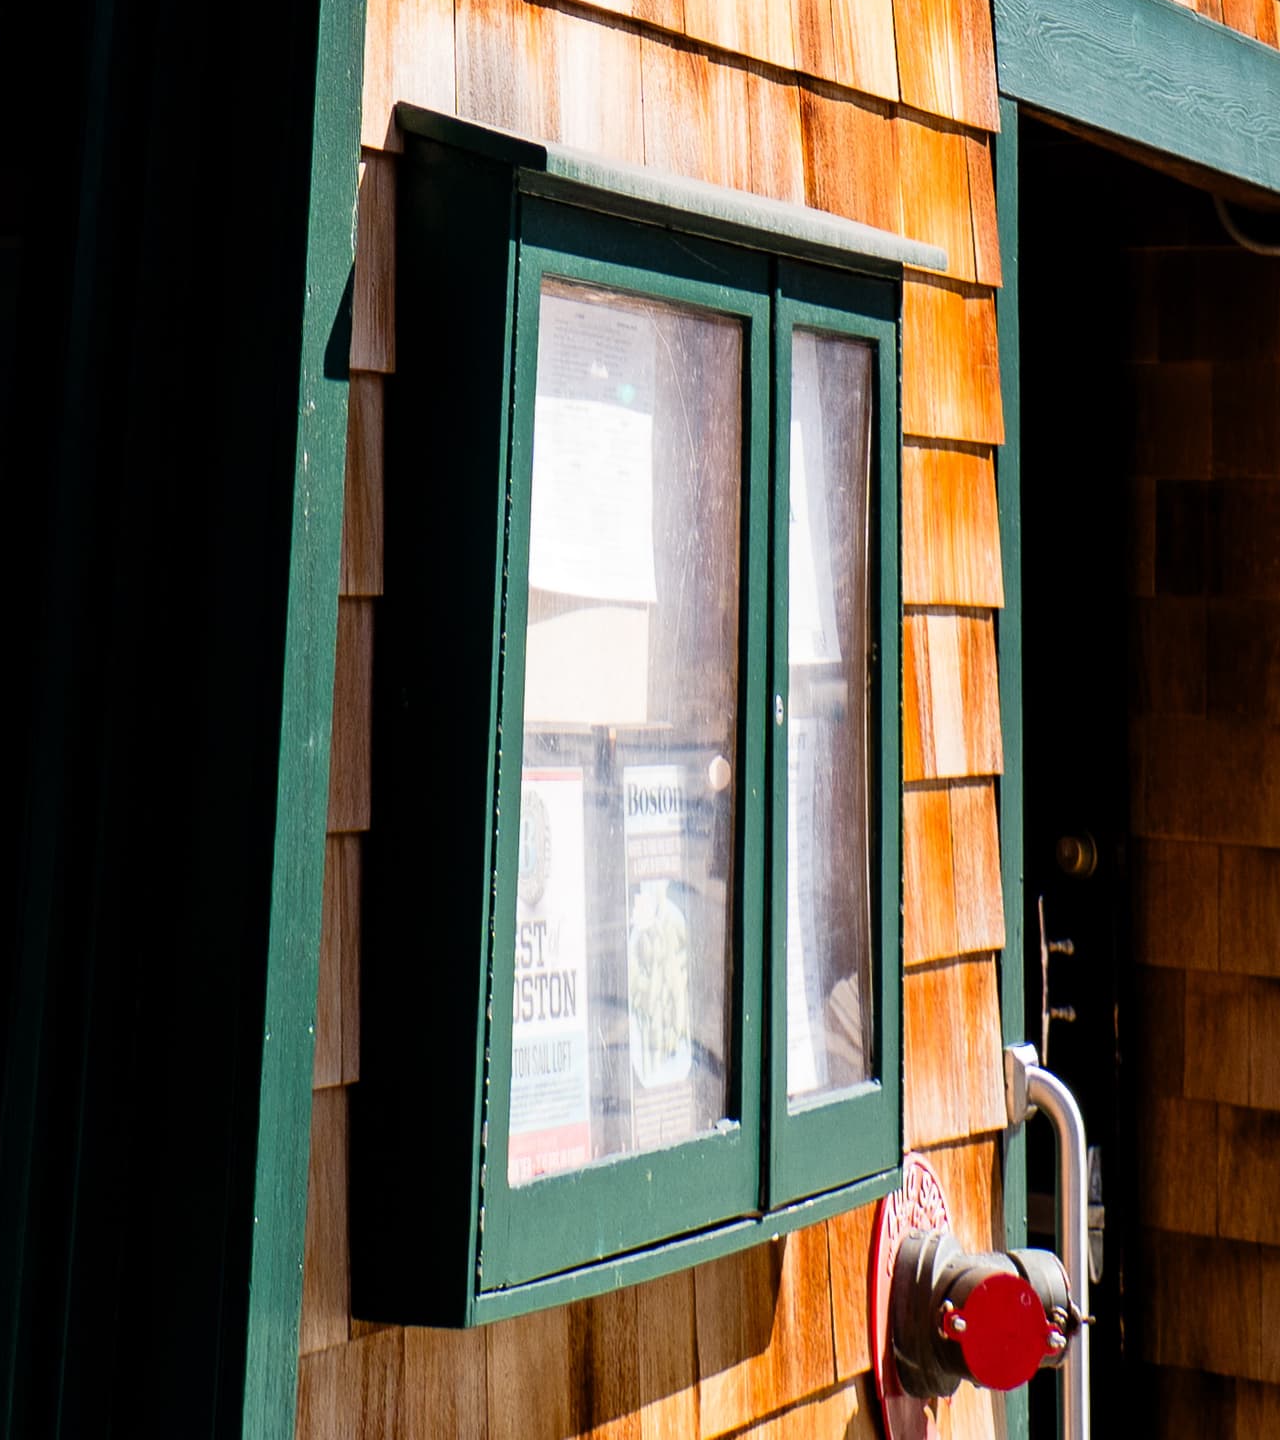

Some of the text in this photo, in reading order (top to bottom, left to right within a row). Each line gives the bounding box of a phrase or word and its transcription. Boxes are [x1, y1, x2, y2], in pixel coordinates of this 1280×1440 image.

[627, 781, 684, 816] Boston
[516, 919, 547, 969] ST
[514, 970, 577, 1023] STON
